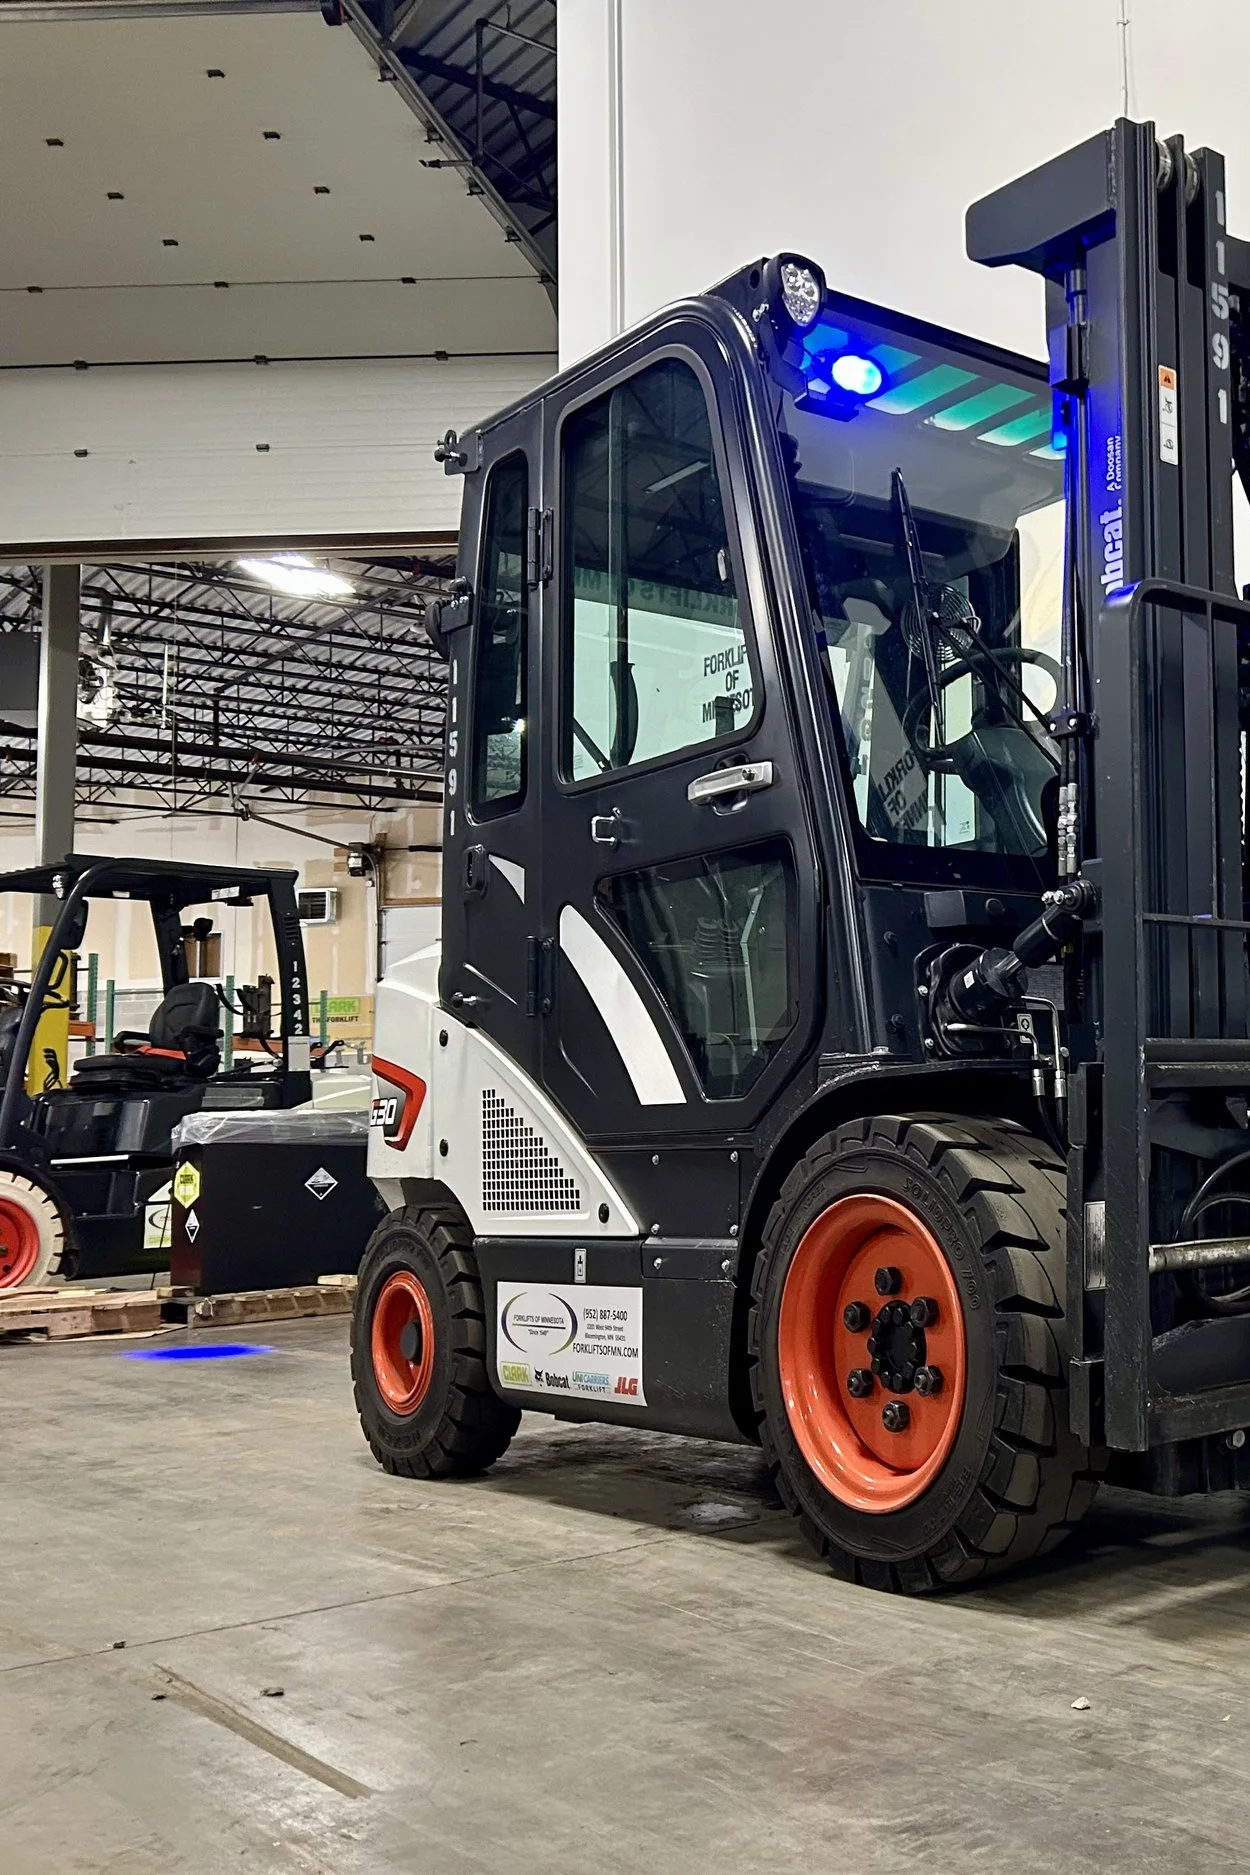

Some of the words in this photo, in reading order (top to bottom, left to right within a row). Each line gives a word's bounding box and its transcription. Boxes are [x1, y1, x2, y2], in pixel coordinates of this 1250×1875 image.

[1106, 436, 1114, 481] Doosan
[1100, 505, 1124, 596] bcat
[704, 645, 747, 677] FORKLIF
[726, 670, 739, 692] OF
[583, 1308, 598, 1321] (952)
[599, 1309, 628, 1322] 887-5400
[573, 1343, 639, 1359] FORKLIFTSOFMN.COM
[503, 1365, 529, 1383] CLARK
[545, 1372, 570, 1389] Bobcat
[615, 1377, 638, 1396] JLG
